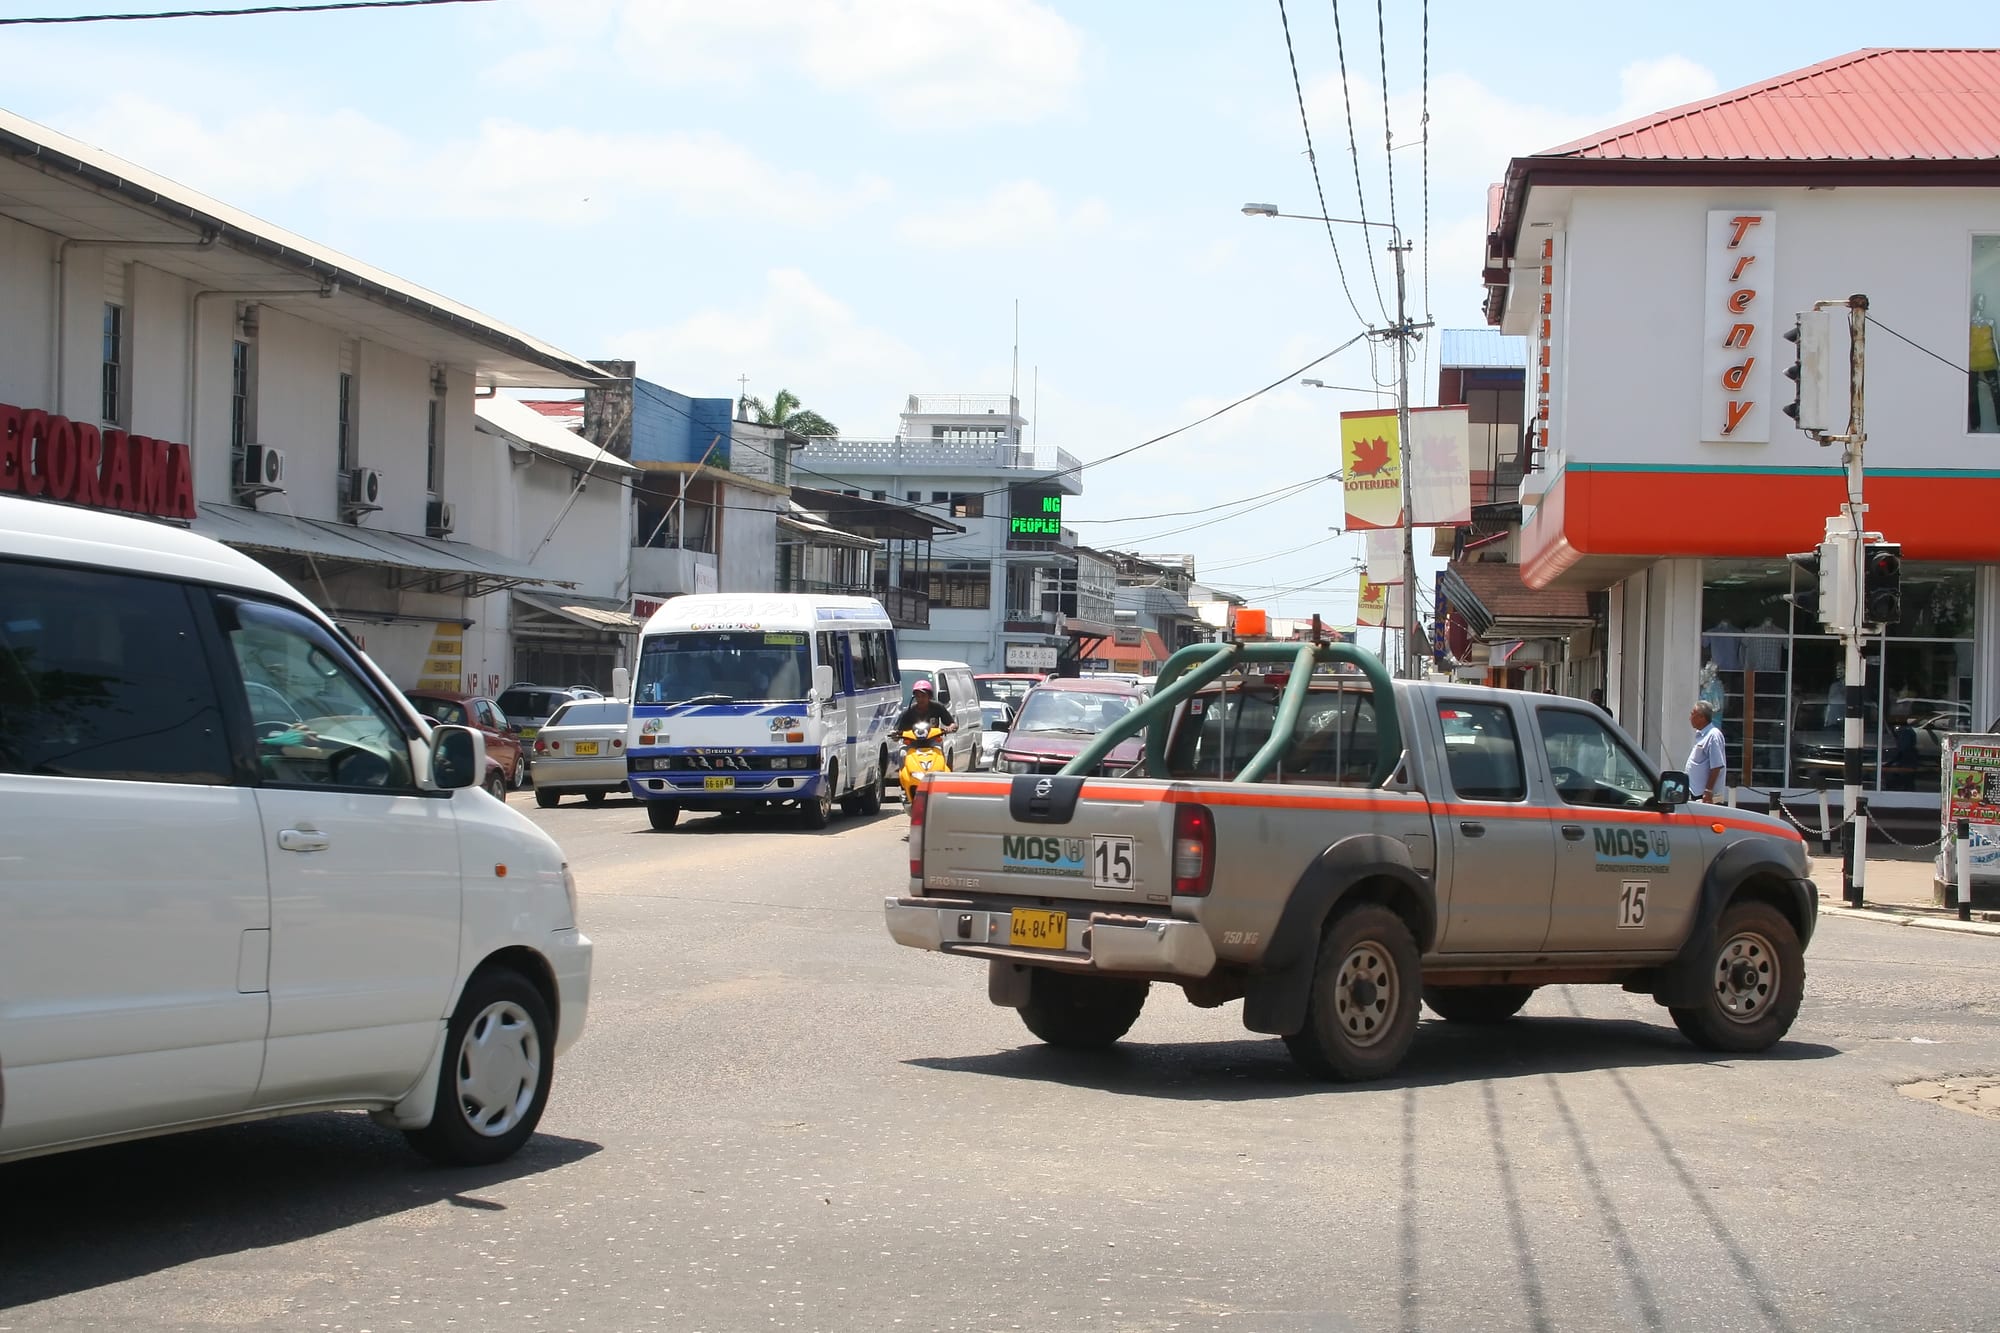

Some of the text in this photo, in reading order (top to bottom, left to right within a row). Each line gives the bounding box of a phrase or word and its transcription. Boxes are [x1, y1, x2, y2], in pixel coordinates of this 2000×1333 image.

[1720, 216, 1763, 436] Trendy
[1043, 497, 1060, 512] NG
[1011, 517, 1060, 534] PEOPLE!
[1953, 808, 1971, 816] ZAT
[1003, 835, 1060, 863] MOS
[1592, 827, 1648, 859] MOS
[1095, 840, 1132, 884] 15
[929, 876, 980, 888] FRONTIER
[1620, 886, 1646, 924] 15
[1223, 931, 1242, 944] 750
